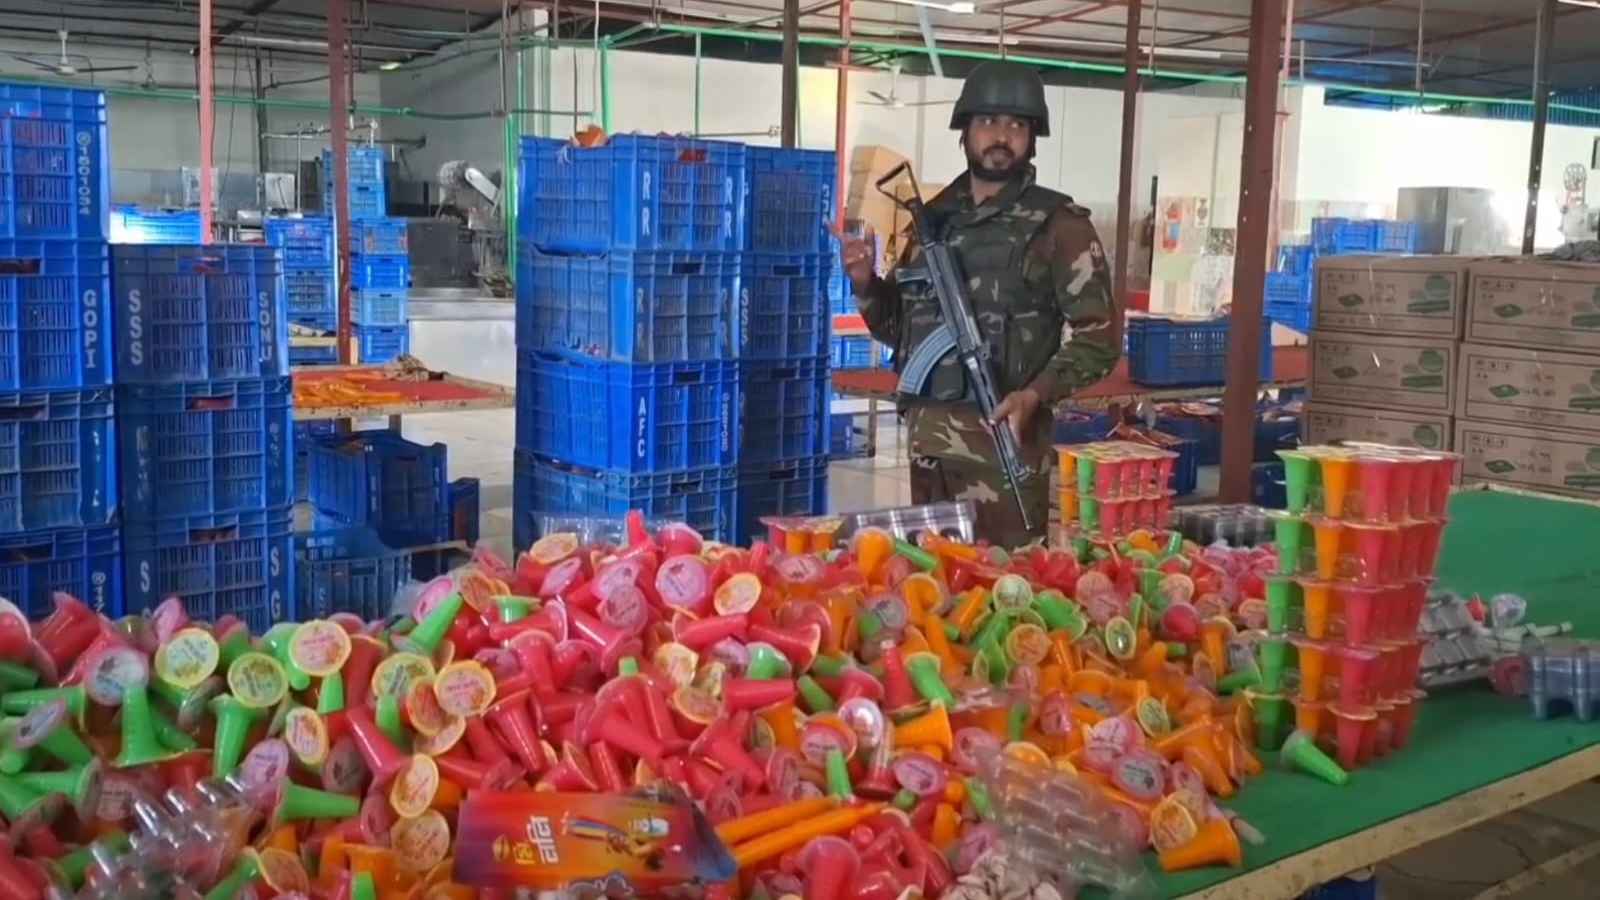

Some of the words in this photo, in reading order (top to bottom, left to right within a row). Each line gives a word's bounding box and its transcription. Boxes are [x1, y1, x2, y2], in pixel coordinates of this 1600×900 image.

[642, 171, 651, 237] RR
[725, 177, 733, 239] RR
[83, 288, 98, 369] GOPI
[128, 289, 144, 365] SSS
[259, 291, 273, 361] SONU
[638, 396, 647, 457] AFC
[270, 546, 281, 619] SG
